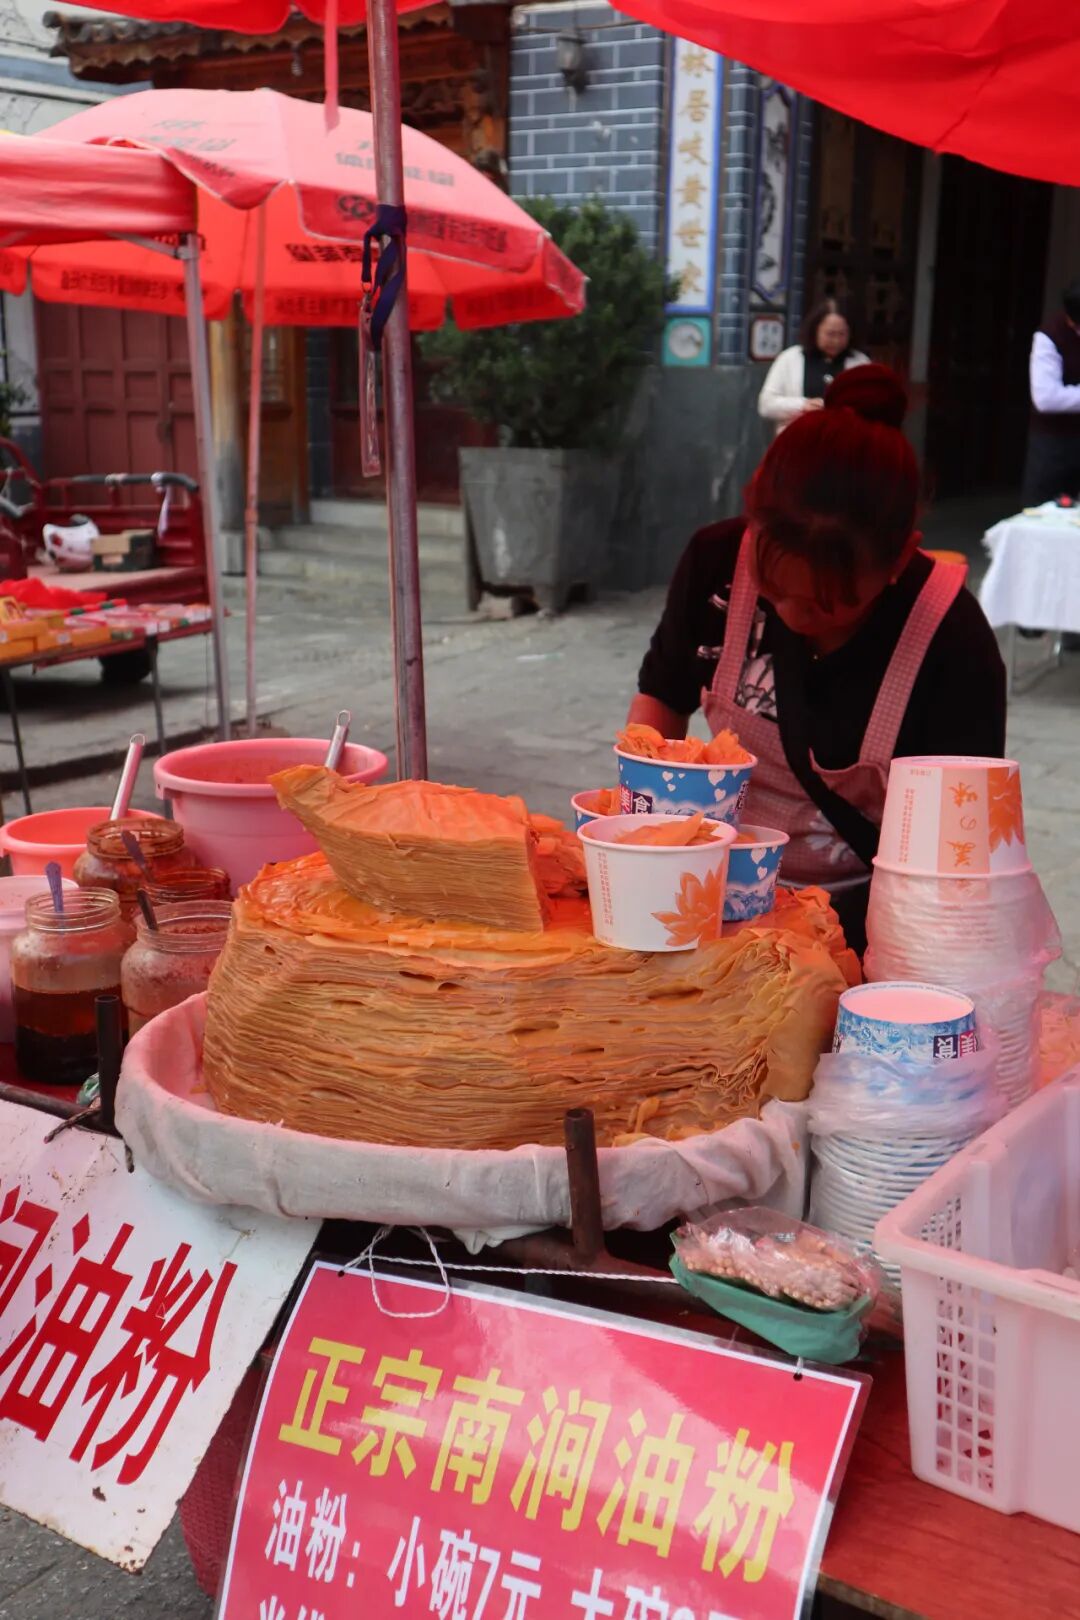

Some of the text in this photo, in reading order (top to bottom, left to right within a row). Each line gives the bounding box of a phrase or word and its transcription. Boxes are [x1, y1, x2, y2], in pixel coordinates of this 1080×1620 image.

[278, 1336, 795, 1584] 正宗南涧油粉
